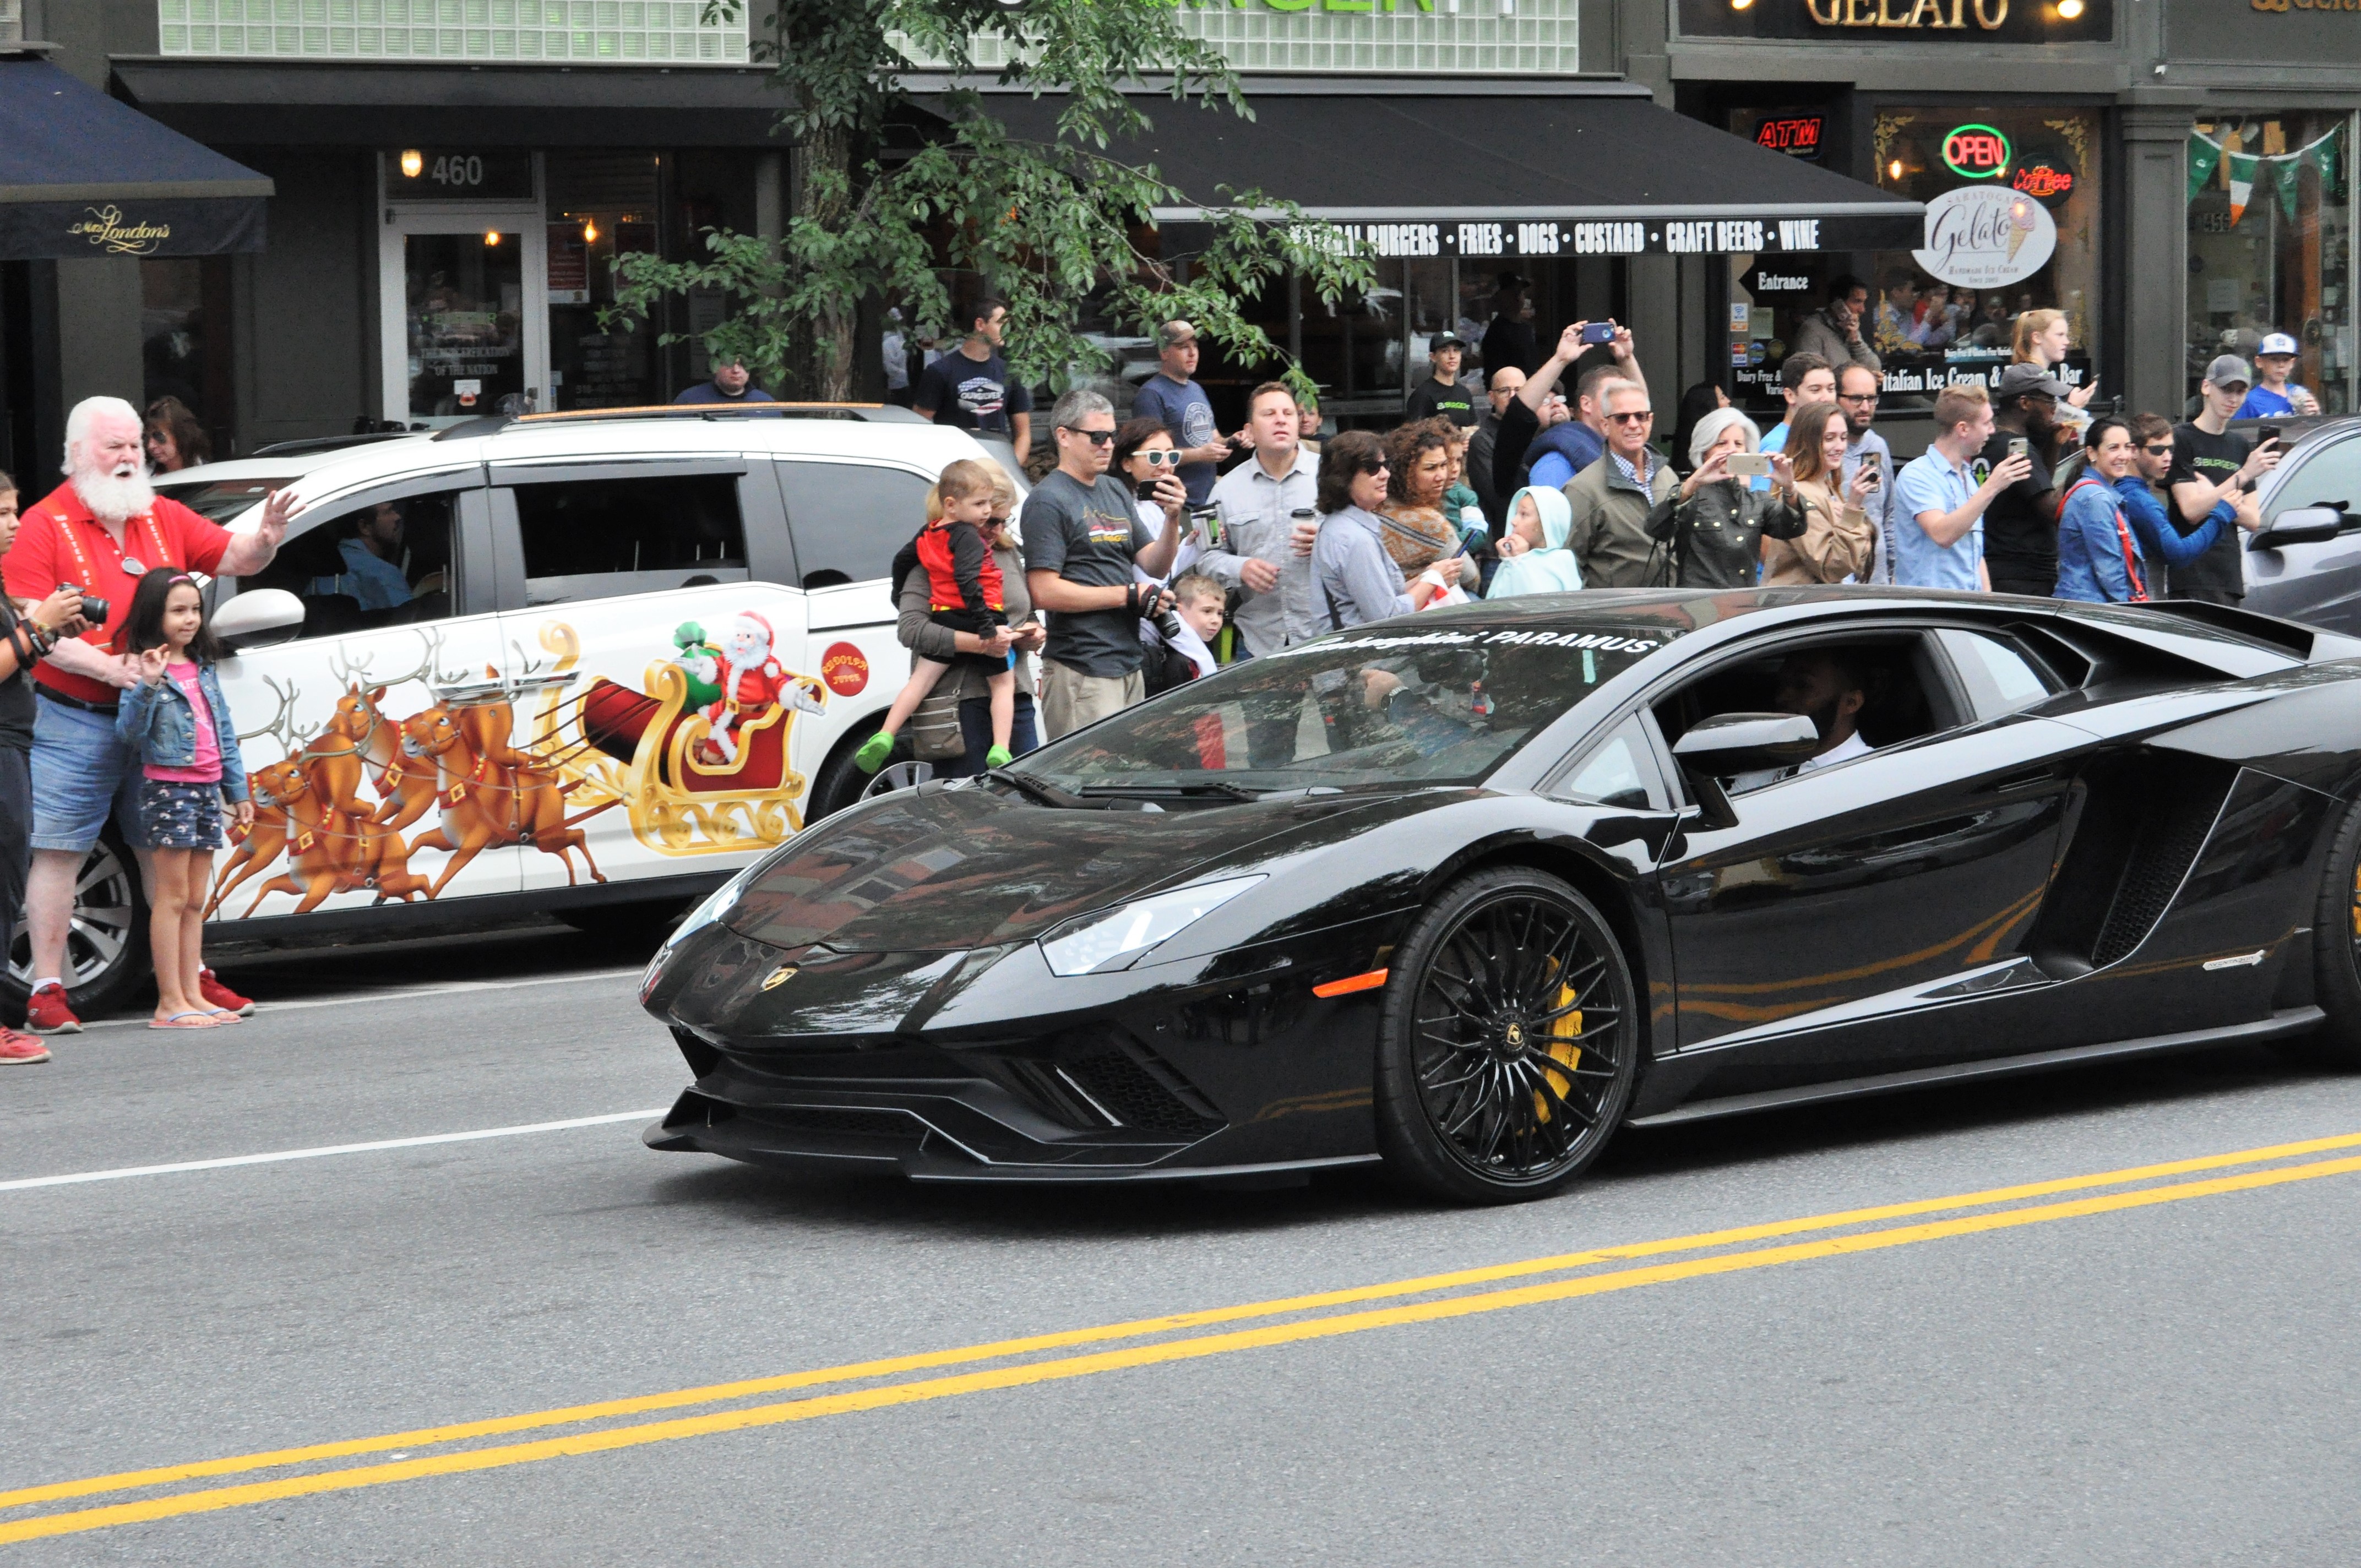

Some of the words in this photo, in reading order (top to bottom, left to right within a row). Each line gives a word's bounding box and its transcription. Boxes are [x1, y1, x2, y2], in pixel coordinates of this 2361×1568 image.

[1757, 118, 1821, 148] ATM
[1946, 136, 2003, 165] OPEN
[432, 155, 483, 186] 460
[2013, 168, 2072, 190] Coffee
[85, 205, 170, 254] London's
[1367, 225, 1439, 257] BURGERS
[1458, 224, 1502, 254] FRIES
[1518, 223, 1559, 254] DOGS
[1575, 222, 1644, 253] CUSTARD
[1666, 222, 1713, 252] CRAFT
[1717, 221, 1764, 251] BEERS
[1779, 220, 1819, 250] WINE
[1932, 201, 2010, 274] Gelato
[1758, 271, 1808, 290] Entrance
[1737, 370, 1756, 384] Dairy
[1758, 369, 1774, 382] Free
[1926, 368, 1944, 390] Ice
[1947, 366, 1987, 388] Cream
[1989, 366, 2000, 388] &
[2060, 363, 2082, 384] Bar
[1144, 595, 1158, 618] Canon
[1483, 630, 1658, 654] PARAMUS
[832, 673, 861, 684] JUICE
